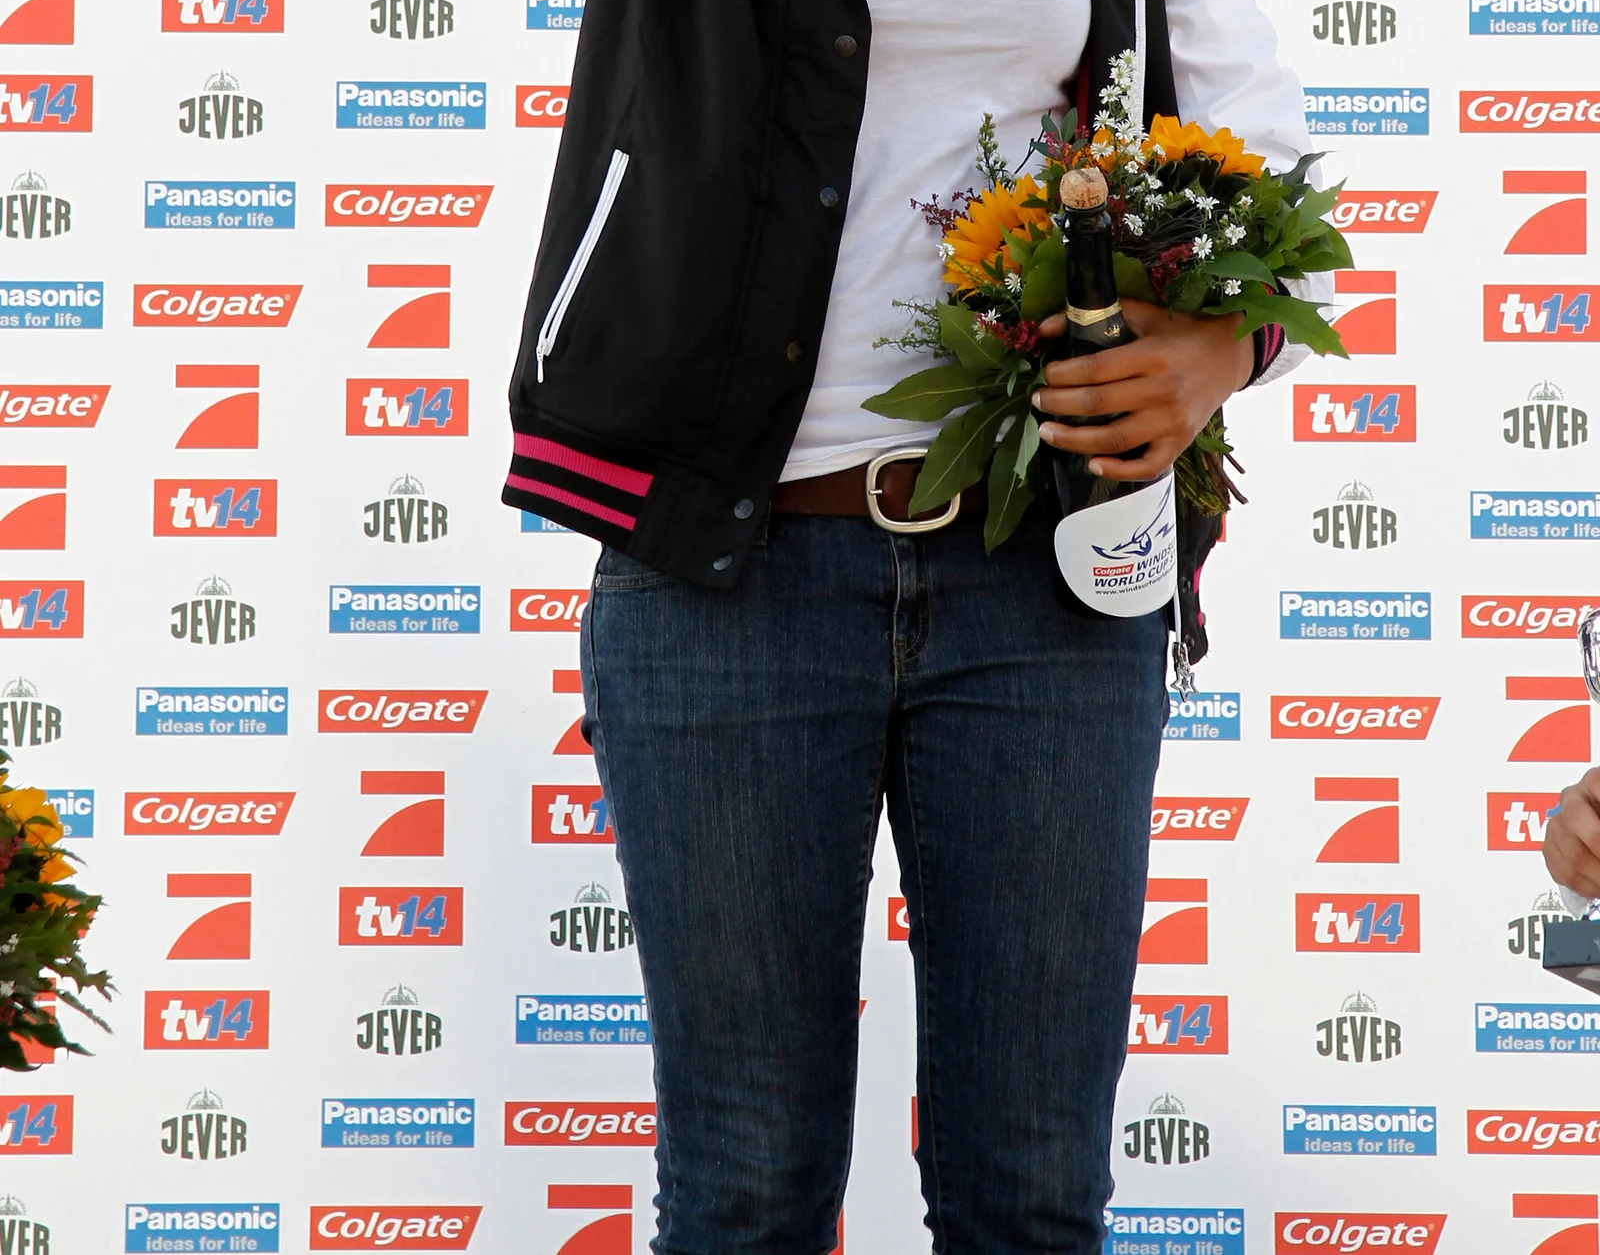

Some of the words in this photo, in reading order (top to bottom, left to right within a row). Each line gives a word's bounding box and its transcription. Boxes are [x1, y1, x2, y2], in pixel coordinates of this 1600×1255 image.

[1313, 0, 1396, 46] JEVER
[1487, 16, 1538, 33] ideas
[1540, 16, 1568, 33] for
[1569, 16, 1600, 33] life
[339, 85, 484, 108] Panasonic
[1306, 90, 1427, 114] anasonic
[179, 94, 263, 140] JEVER
[356, 111, 405, 125] ideas
[407, 111, 435, 125] for
[437, 111, 466, 125] life
[1349, 116, 1378, 132] for
[1379, 116, 1409, 132] life
[147, 184, 293, 208] Panasonic
[334, 190, 476, 223] Colgate
[0, 193, 71, 240] EVER
[164, 210, 213, 226] ideas
[216, 210, 244, 226] for
[245, 210, 275, 226] life
[1340, 197, 1421, 226] gate
[23, 310, 51, 325] for
[53, 310, 83, 325] life
[142, 290, 285, 323] Colgate
[1500, 293, 1592, 335] tv14
[363, 387, 454, 429] tv14
[1310, 394, 1401, 435] tv14
[1503, 404, 1588, 450] JEVER
[171, 488, 262, 529] tv14
[363, 497, 448, 544] JEVER
[1313, 504, 1397, 550] JEVER
[1489, 520, 1540, 537] ideas
[1541, 520, 1571, 537] for
[1094, 565, 1132, 576] Colgate
[1094, 572, 1145, 587] WORLD
[332, 588, 478, 612] Panasonic
[1282, 595, 1429, 619] Panasonic
[171, 598, 256, 645] JEVER
[349, 615, 398, 630] ideas
[401, 615, 429, 630] for
[431, 615, 460, 630] life
[1299, 620, 1349, 638] ideas
[1351, 620, 1379, 638] for
[1381, 620, 1411, 638] life
[139, 690, 286, 714] Panasonic
[327, 695, 470, 729] Colgate
[156, 717, 205, 731] ideas
[208, 717, 236, 731] for
[238, 717, 268, 731] life
[1279, 702, 1423, 735] Colgate
[133, 797, 278, 831] Colgate
[356, 896, 448, 938] tv14
[1313, 902, 1405, 945] tv14
[162, 999, 254, 1042] tv14
[518, 997, 647, 1022] Panasoni
[356, 1008, 442, 1056] JEVER
[536, 1026, 585, 1041] ideas
[588, 1026, 615, 1041] for
[618, 1026, 647, 1041] life
[1316, 1015, 1402, 1063] JEVER
[1495, 1033, 1545, 1050] ideas
[1548, 1033, 1576, 1050] for
[324, 1101, 472, 1125] Panasonic
[513, 1108, 656, 1142] Colgate
[1286, 1107, 1434, 1133] Panasonic
[161, 1113, 247, 1161] JEVER
[342, 1129, 391, 1144] ideas
[394, 1129, 422, 1144] for
[424, 1129, 454, 1144] life
[1123, 1117, 1210, 1166] JEVER
[1303, 1136, 1353, 1151] ideas
[1356, 1136, 1384, 1151] for
[1386, 1136, 1416, 1151] life
[128, 1205, 277, 1231] Panasonic
[319, 1212, 464, 1246] Colgate
[145, 1234, 195, 1249] ideas
[198, 1234, 226, 1249] for
[228, 1234, 259, 1249] life
[1112, 1239, 1161, 1253] ideas
[1164, 1239, 1191, 1253] for
[1195, 1239, 1224, 1253] life
[1284, 1219, 1429, 1253] Colgate
